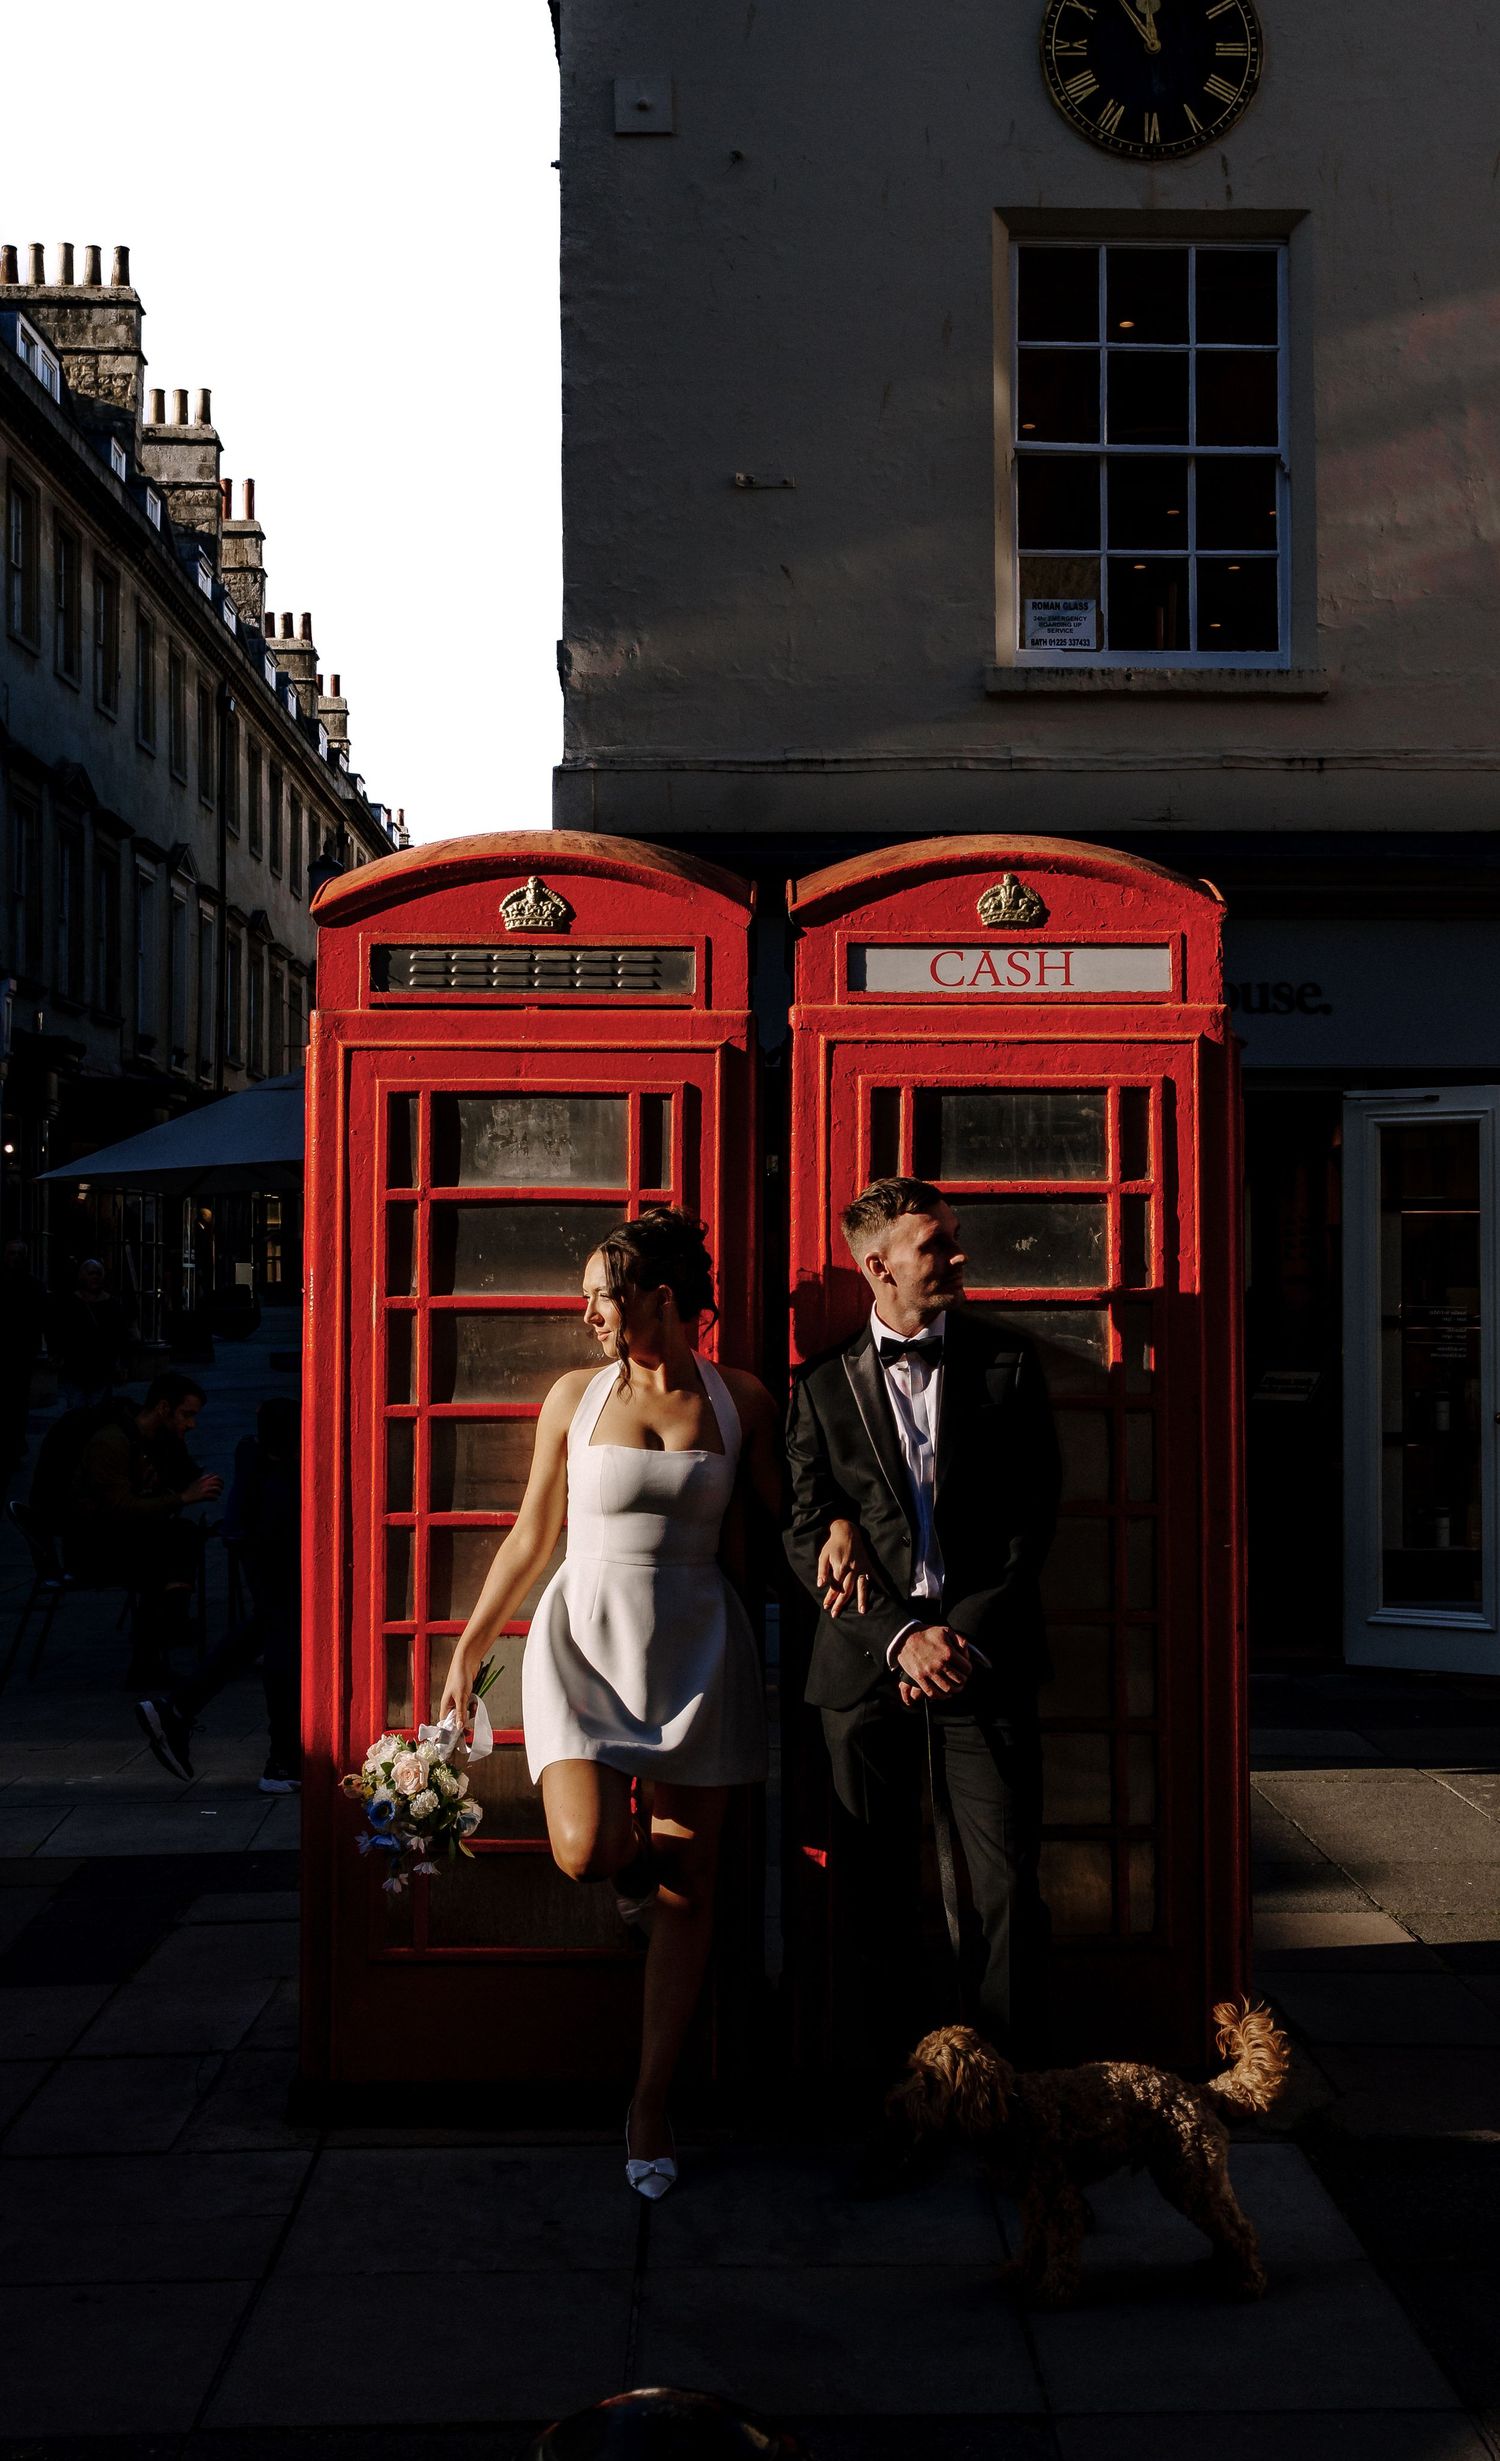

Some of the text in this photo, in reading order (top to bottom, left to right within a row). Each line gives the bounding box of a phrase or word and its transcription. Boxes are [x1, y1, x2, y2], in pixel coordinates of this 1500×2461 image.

[1031, 601, 1089, 611] ROMAN GLASS
[1031, 638, 1047, 646] BATH
[1049, 638, 1067, 646] 01225
[930, 950, 1075, 988] CASH
